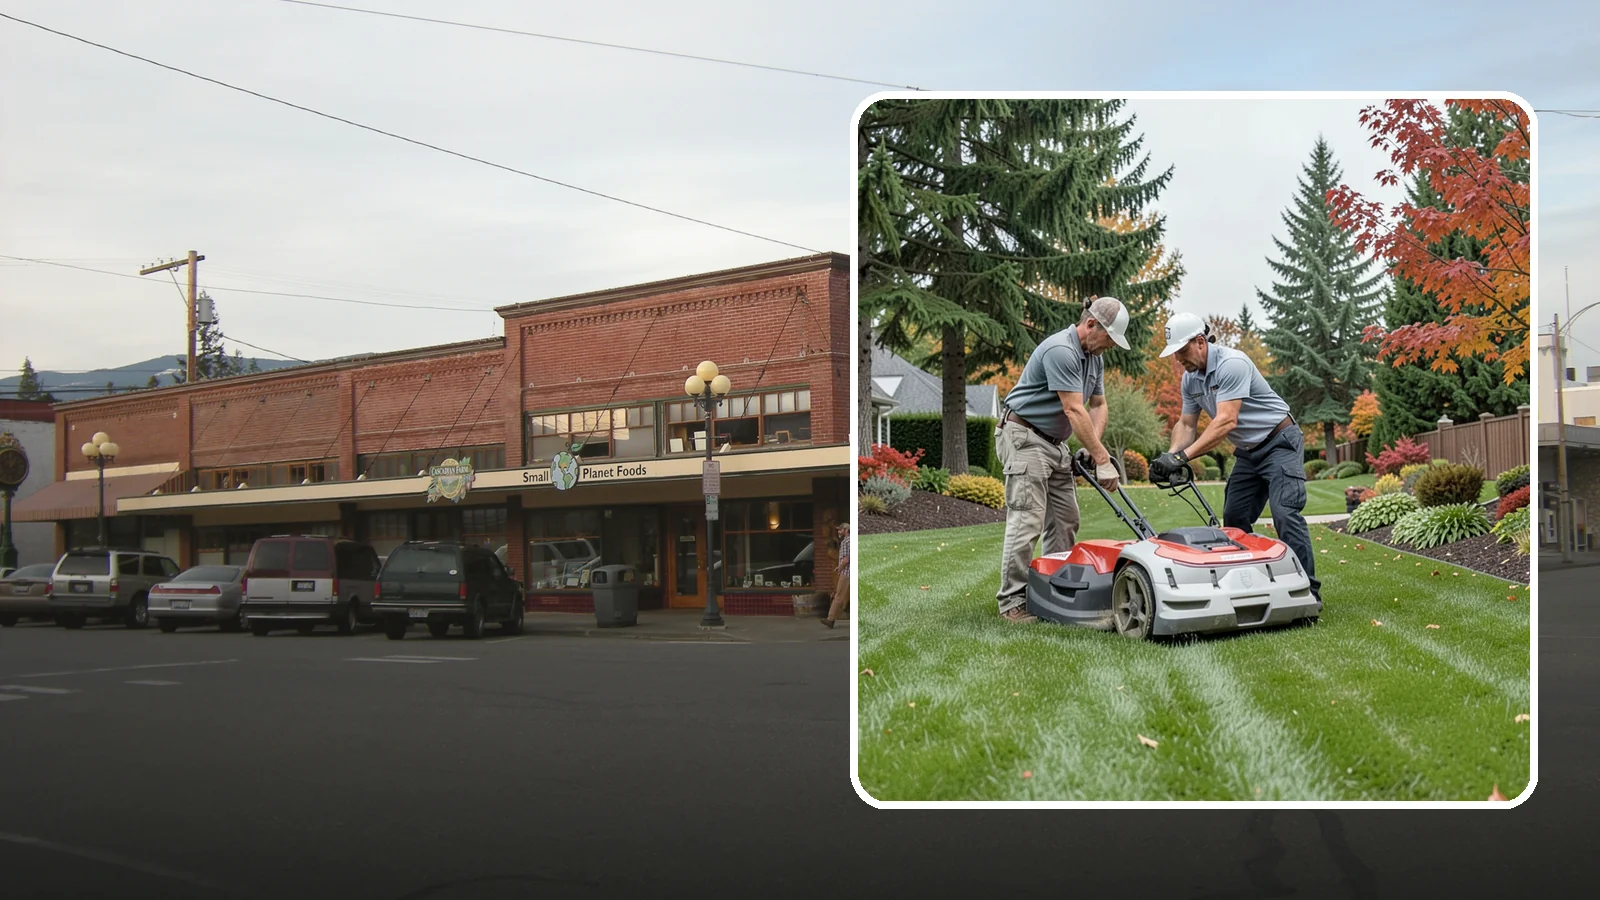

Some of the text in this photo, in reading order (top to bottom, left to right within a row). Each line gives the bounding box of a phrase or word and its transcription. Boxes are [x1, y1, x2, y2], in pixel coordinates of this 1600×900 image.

[523, 464, 646, 482] Small Planet Foods
